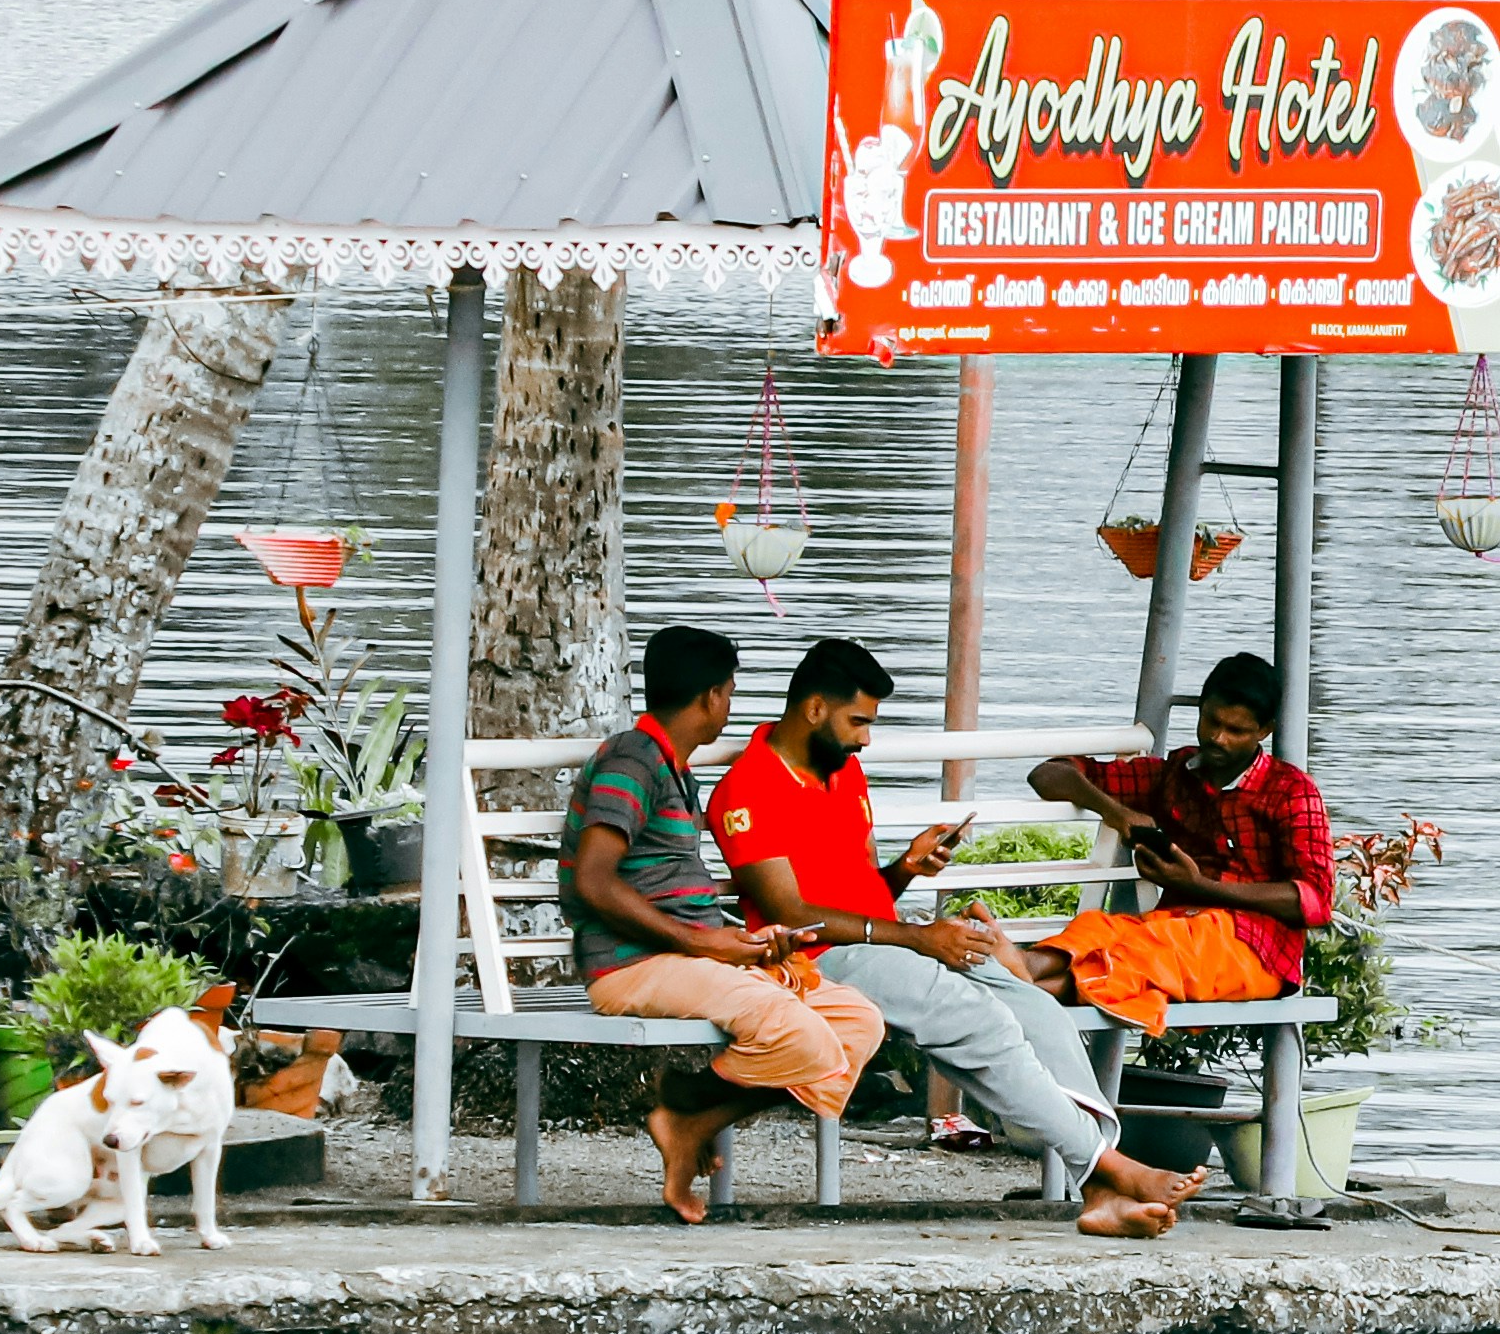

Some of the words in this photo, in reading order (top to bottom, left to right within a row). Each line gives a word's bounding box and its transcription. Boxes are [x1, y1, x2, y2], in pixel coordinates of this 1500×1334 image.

[927, 14, 1203, 180] Ayodhya
[1221, 16, 1380, 163] Hotel
[937, 201, 1092, 246] RESTAURANT
[1099, 202, 1119, 246] &
[1127, 201, 1167, 245] ICE
[1173, 201, 1255, 245] CREAM
[1261, 201, 1369, 245] PARLOUR
[723, 807, 751, 837] 03
